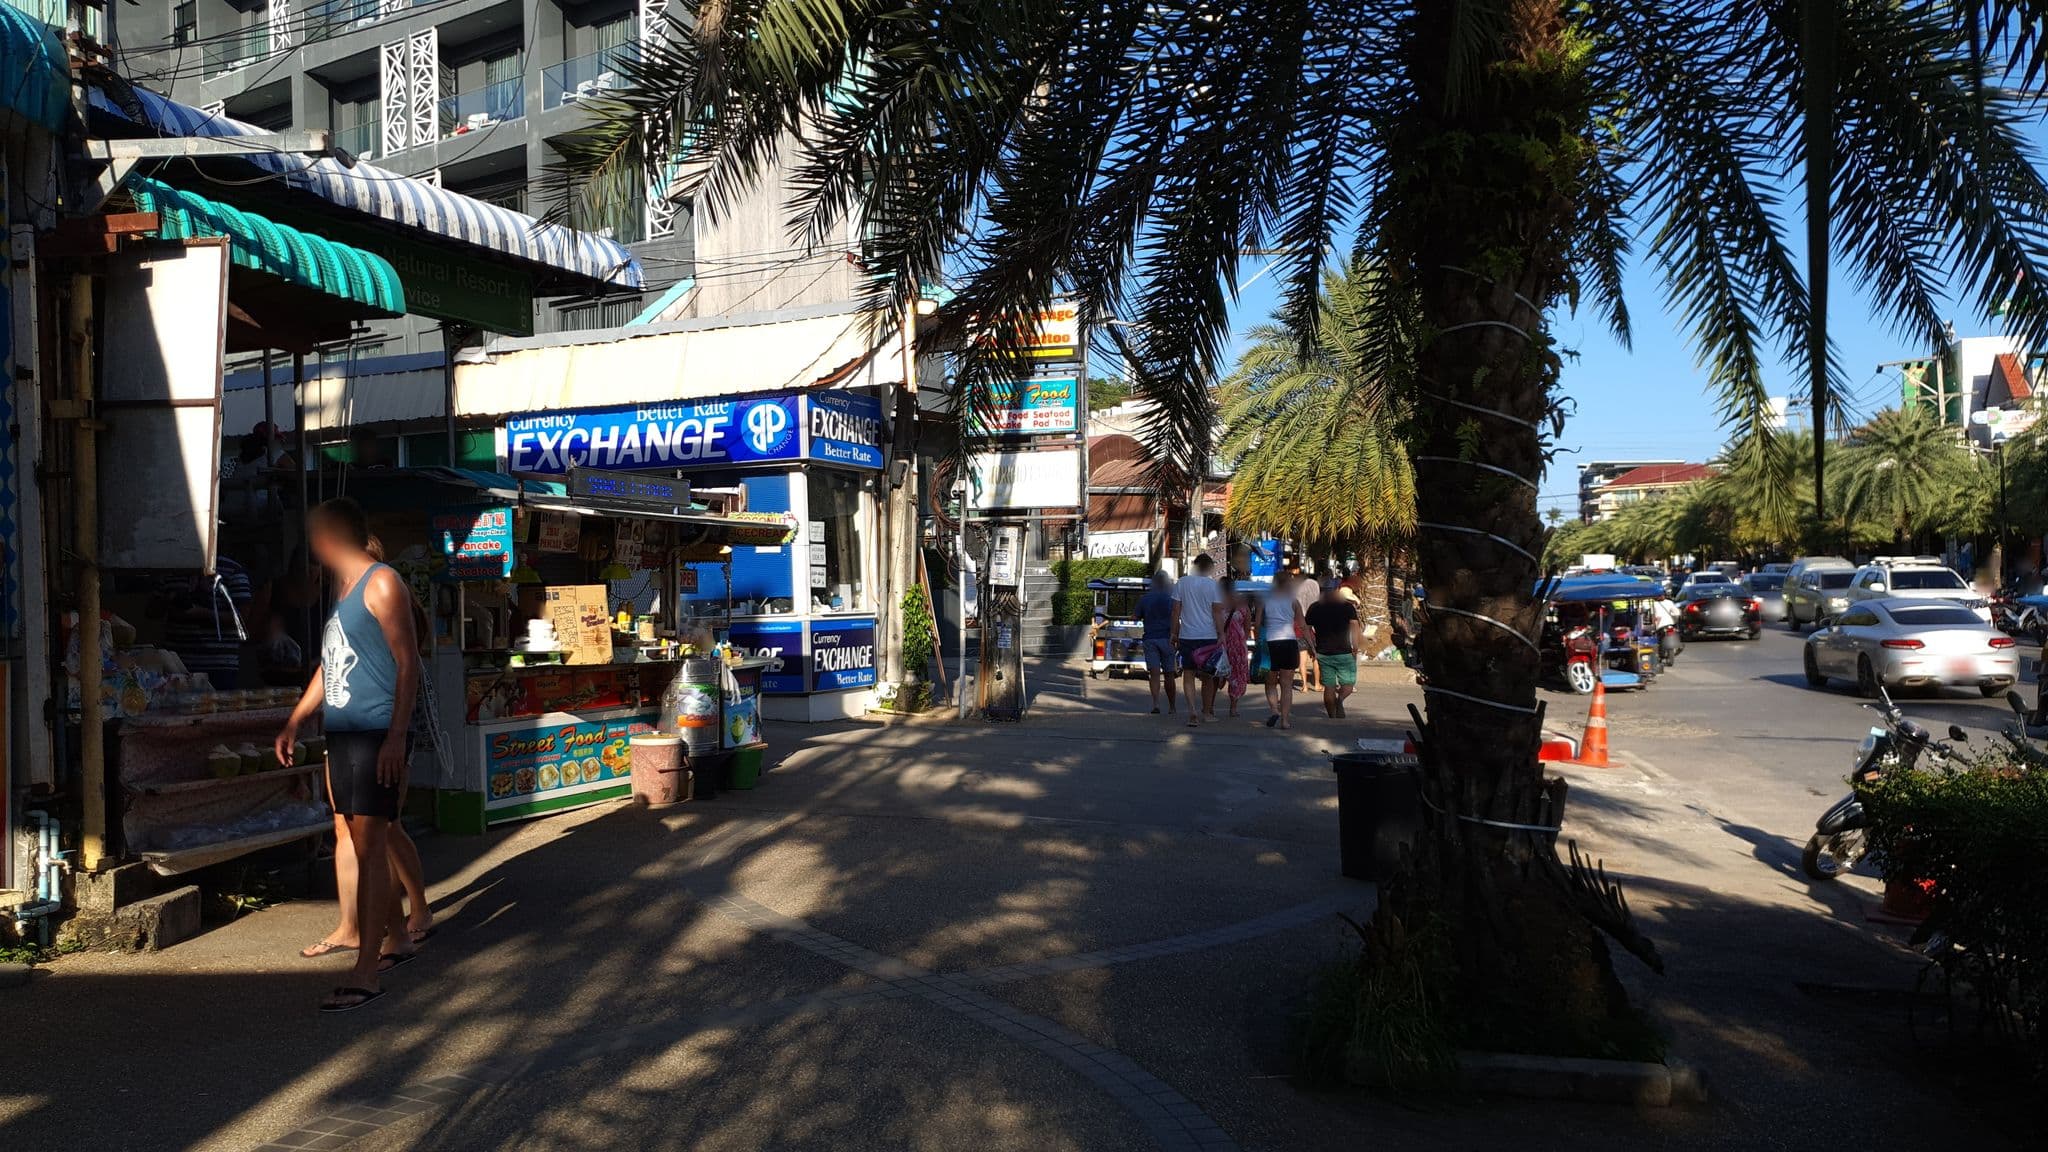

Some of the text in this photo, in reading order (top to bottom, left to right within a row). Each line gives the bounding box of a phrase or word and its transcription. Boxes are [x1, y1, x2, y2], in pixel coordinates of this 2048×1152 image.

[456, 265, 511, 298] Resort
[819, 392, 851, 410] Currency
[1025, 384, 1071, 403] Food
[509, 399, 729, 431] Currency Better Rate
[1008, 411, 1028, 419] Food
[1033, 410, 1070, 419] Seafood
[1055, 419, 1072, 427] Thai
[811, 406, 880, 447] EXCHANGE
[512, 416, 728, 472] EXCHANGE
[824, 442, 872, 463] Better Rate
[1115, 541, 1147, 554] Relax
[812, 632, 842, 647] Currency
[814, 645, 873, 673] EXCHANGE
[762, 679, 778, 689] ate
[836, 672, 873, 685] Better Rate
[492, 733, 556, 760] Street
[558, 724, 607, 753] Food
